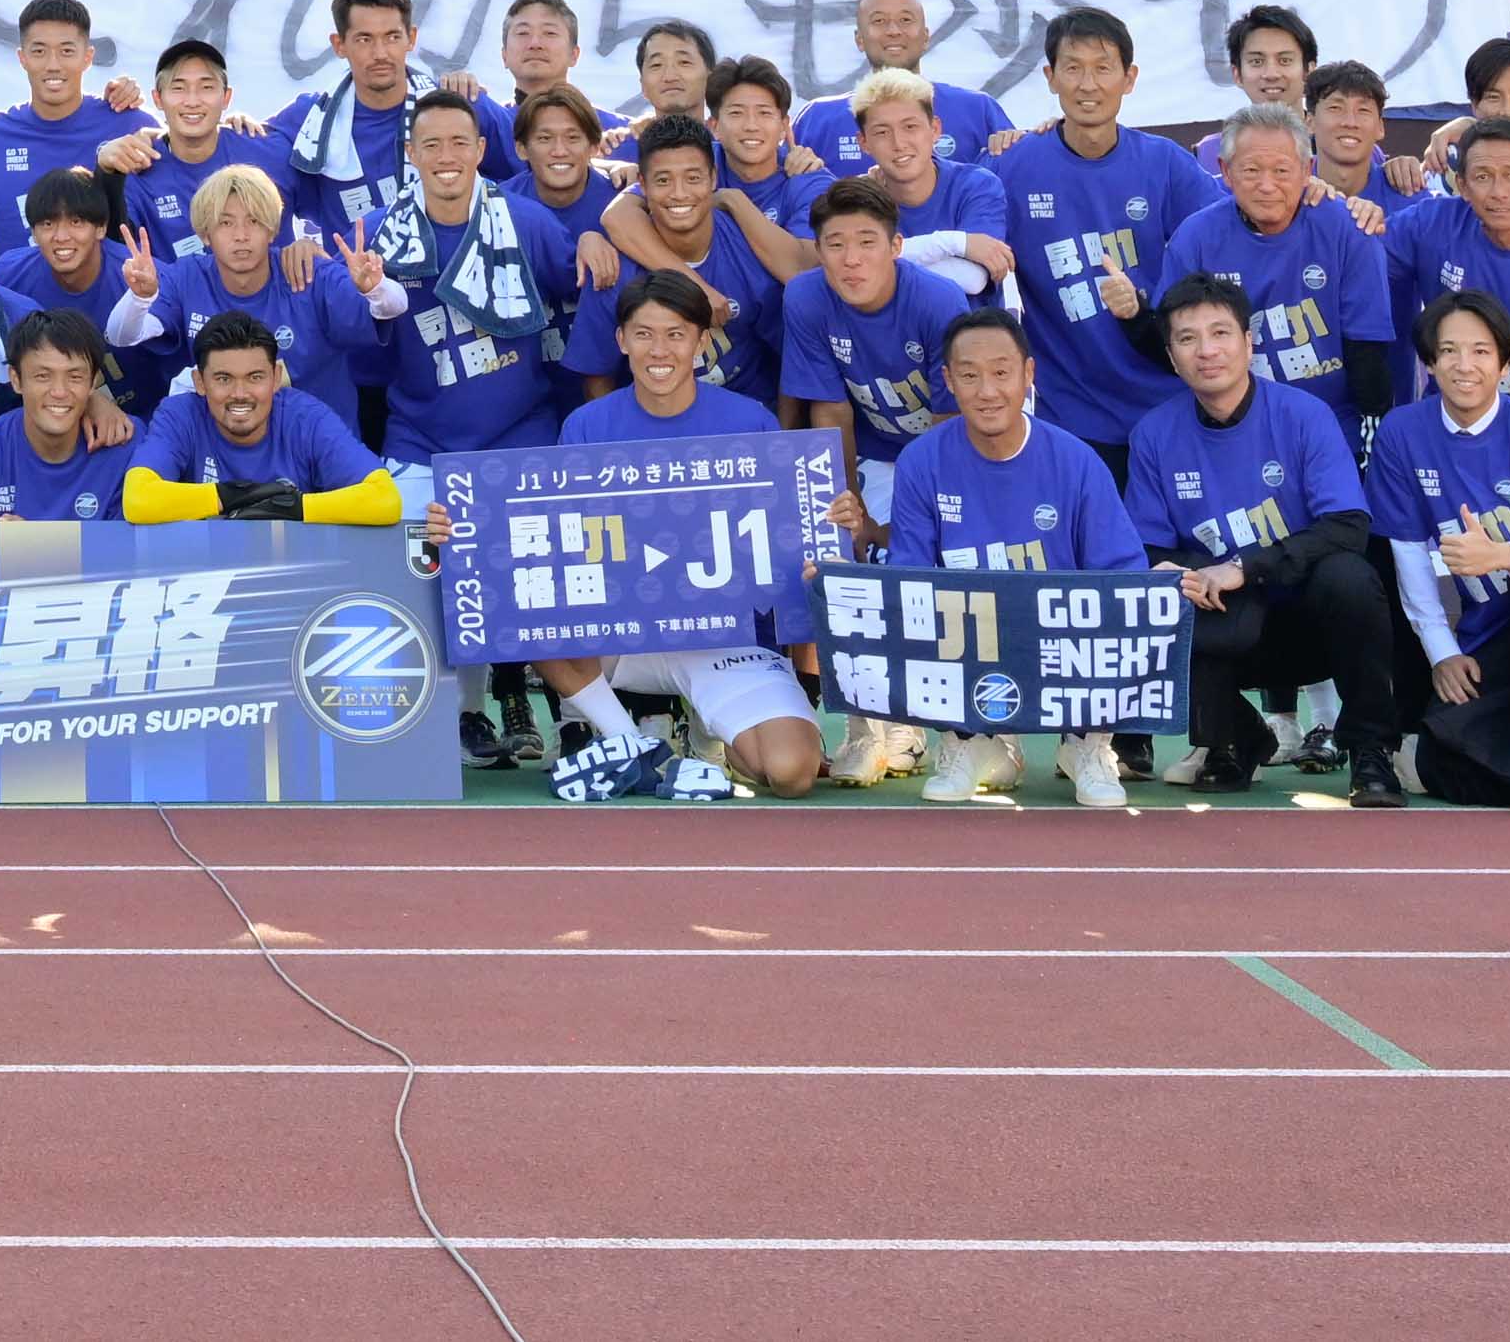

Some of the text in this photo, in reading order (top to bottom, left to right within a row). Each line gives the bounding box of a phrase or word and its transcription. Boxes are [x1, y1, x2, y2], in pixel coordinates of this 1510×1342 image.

[514, 456, 758, 492] J1 リーグゆき片道切符
[686, 507, 776, 590] J1
[517, 613, 739, 644] 発売日当日限り有効 下車前途無効
[933, 589, 1001, 663] J1
[1037, 585, 1182, 629] GO TO
[1040, 634, 1177, 679] THE NEXT
[60, 712, 139, 741] YOUR
[143, 701, 279, 734] SUPPORT
[1040, 679, 1174, 728] STAGE!
